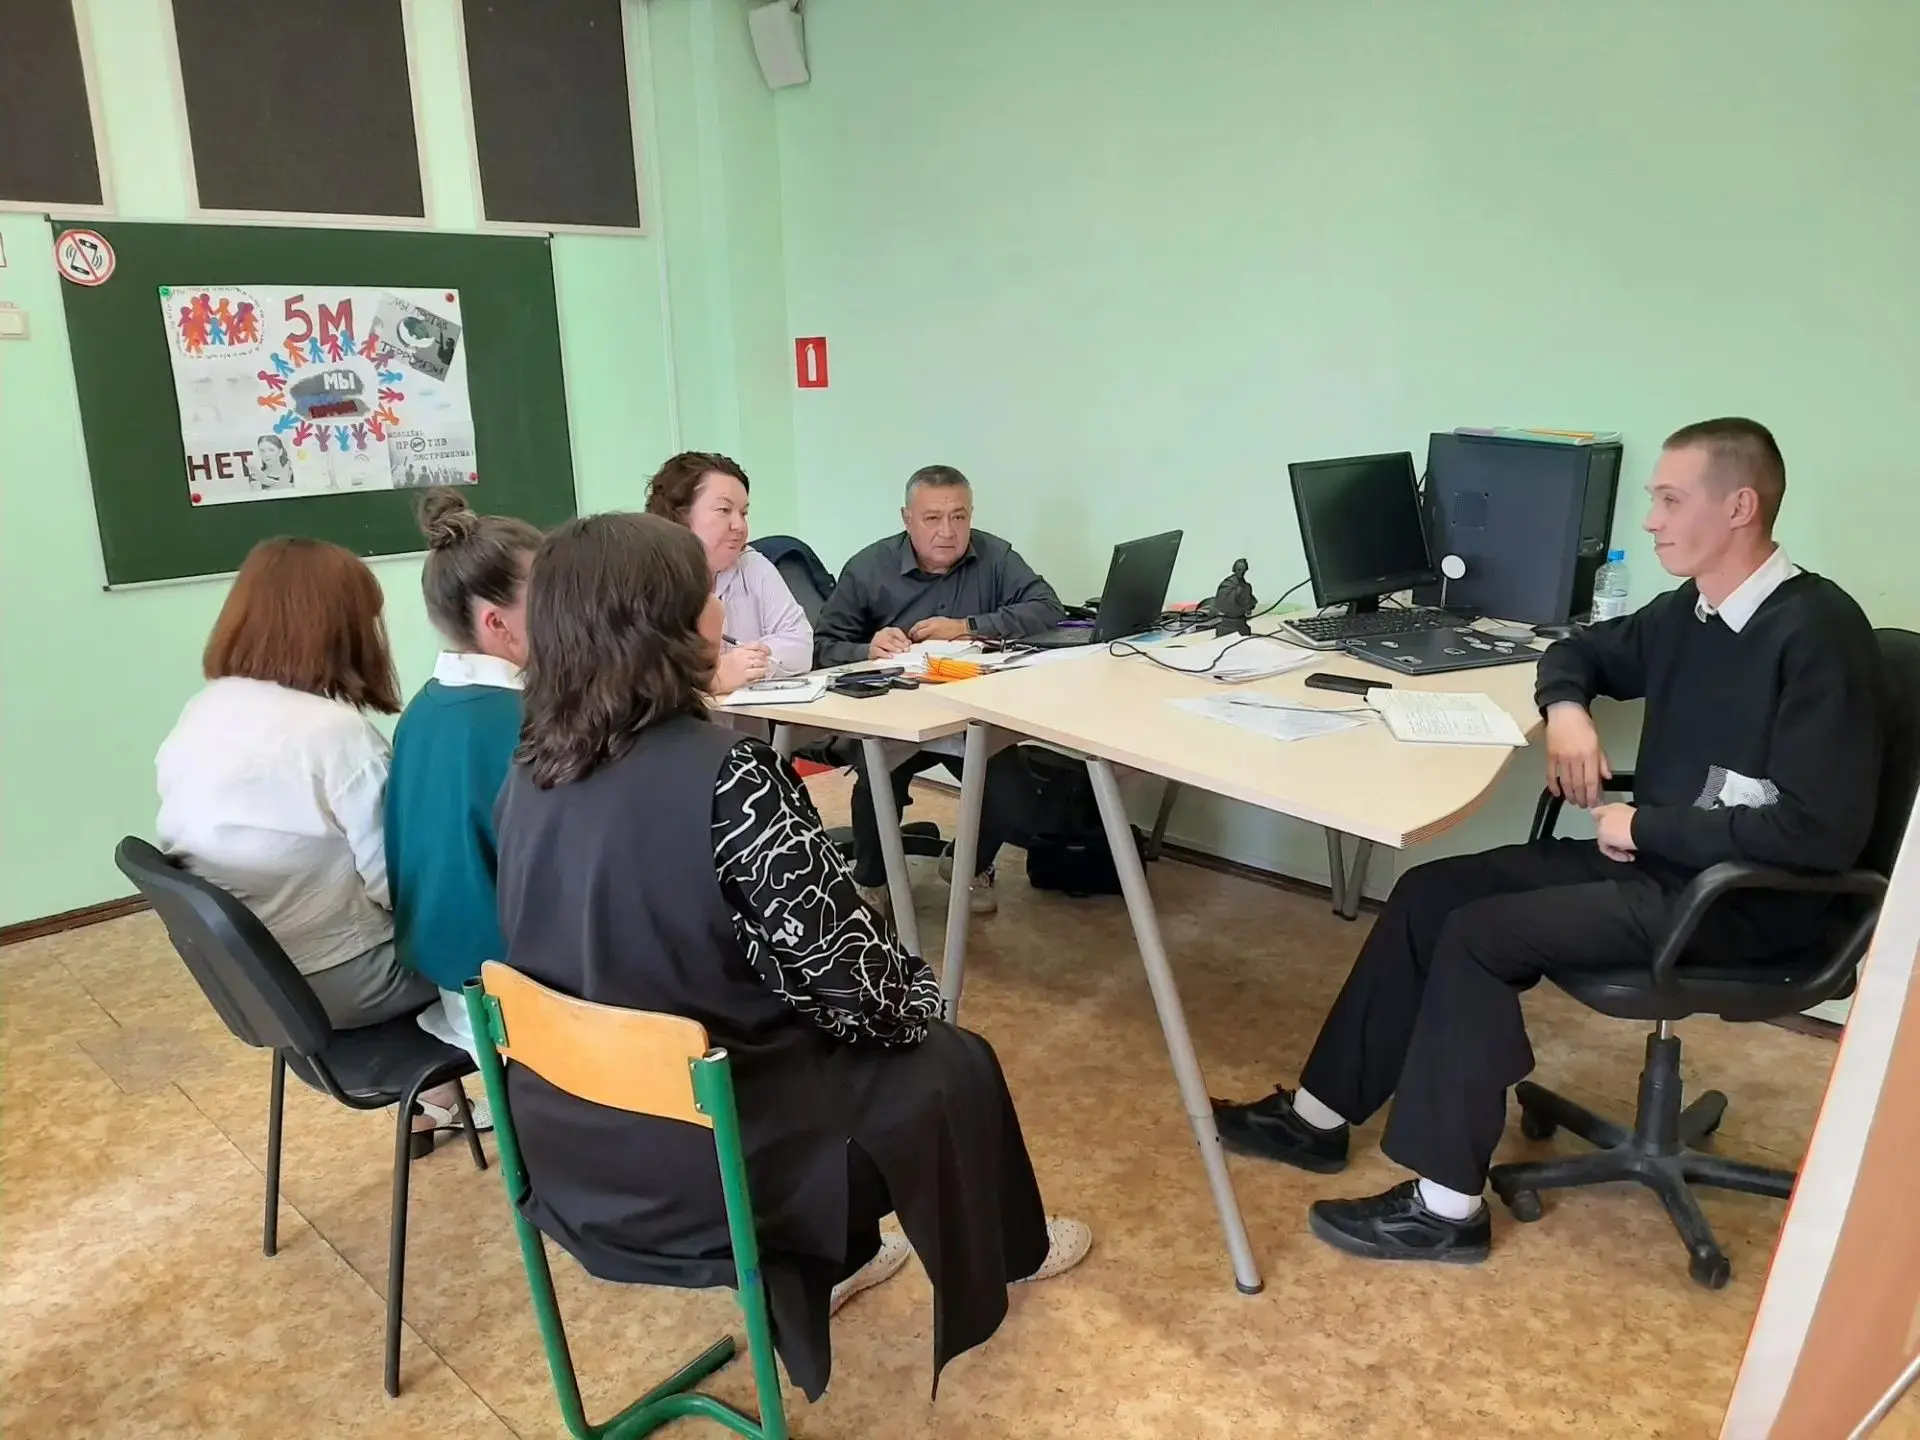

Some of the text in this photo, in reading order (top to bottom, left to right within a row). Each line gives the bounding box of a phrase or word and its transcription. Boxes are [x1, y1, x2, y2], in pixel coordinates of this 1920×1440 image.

[285, 294, 354, 346] 5М
[323, 372, 355, 390] МЫ
[187, 451, 253, 481] НЕТ
